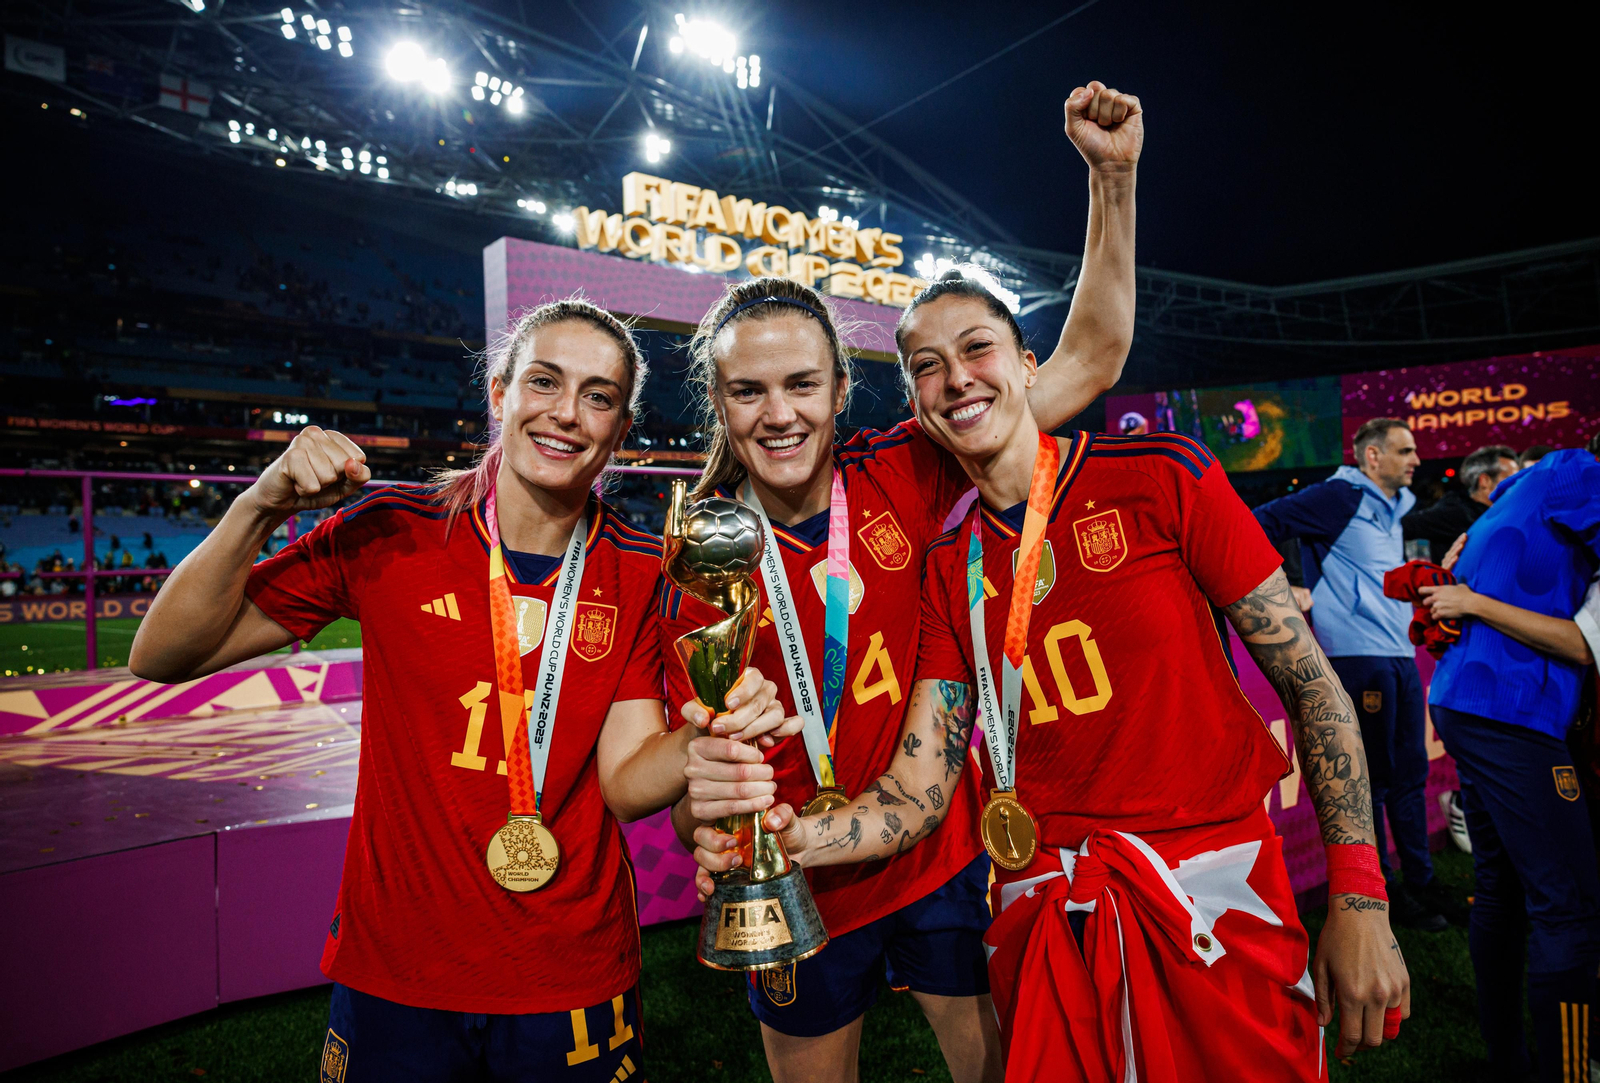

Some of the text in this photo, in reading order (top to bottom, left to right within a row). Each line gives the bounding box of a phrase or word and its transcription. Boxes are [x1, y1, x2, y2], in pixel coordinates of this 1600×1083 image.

[622, 171, 904, 267] FIFA WOMEN'S
[573, 206, 742, 272] WORLD
[830, 262, 928, 303] 202
[1407, 401, 1571, 431] AMPIONS
[1409, 384, 1527, 410] WORLD
[571, 541, 581, 561] FIFA
[560, 562, 577, 610] WOMEN'S
[764, 535, 780, 583] OMEN'S
[773, 583, 790, 622] WORLD
[783, 622, 796, 643] CUP
[22, 601, 122, 621] WORD
[552, 611, 567, 649] WORLD
[548, 650, 559, 673] CUP
[851, 631, 902, 706] 4
[1022, 619, 1113, 726] 10
[451, 681, 535, 776] 1
[980, 667, 1008, 785] FIFA WOMEN'S WORLD
[724, 905, 781, 927] FIFA
[1341, 897, 1387, 913] Karma
